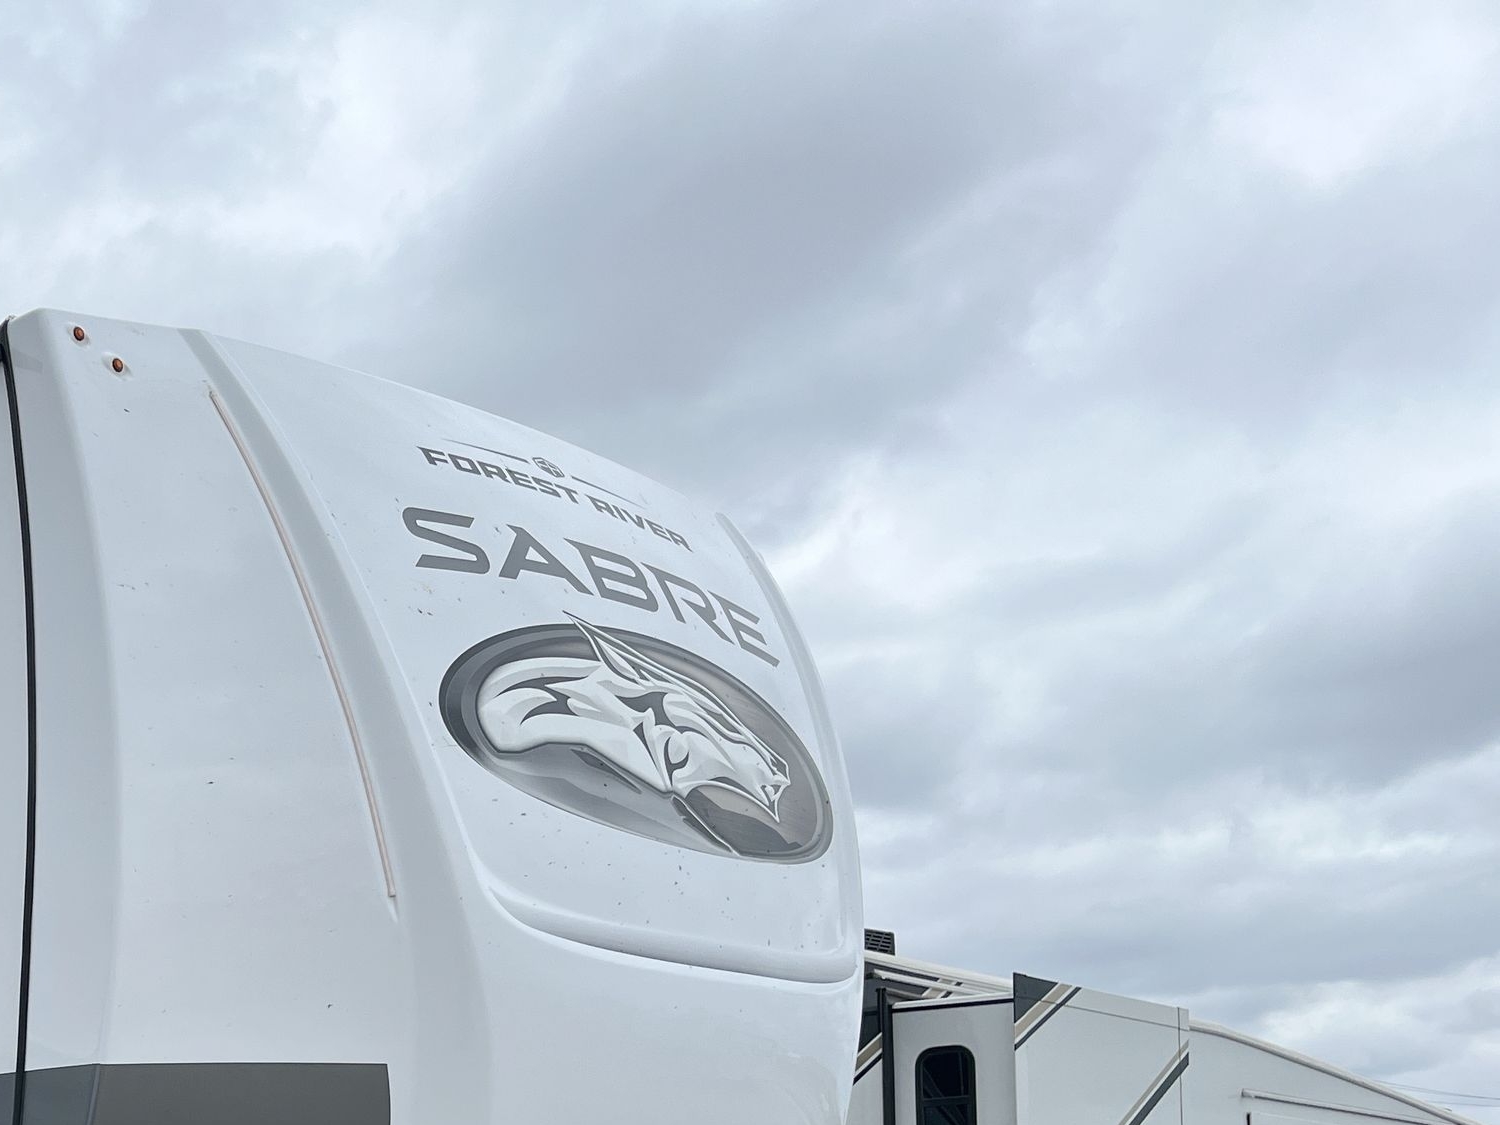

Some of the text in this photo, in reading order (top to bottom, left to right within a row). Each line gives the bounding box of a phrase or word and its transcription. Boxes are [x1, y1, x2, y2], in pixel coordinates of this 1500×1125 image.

[417, 446, 694, 552] FOREST RIVER
[402, 506, 780, 668] SABRE
